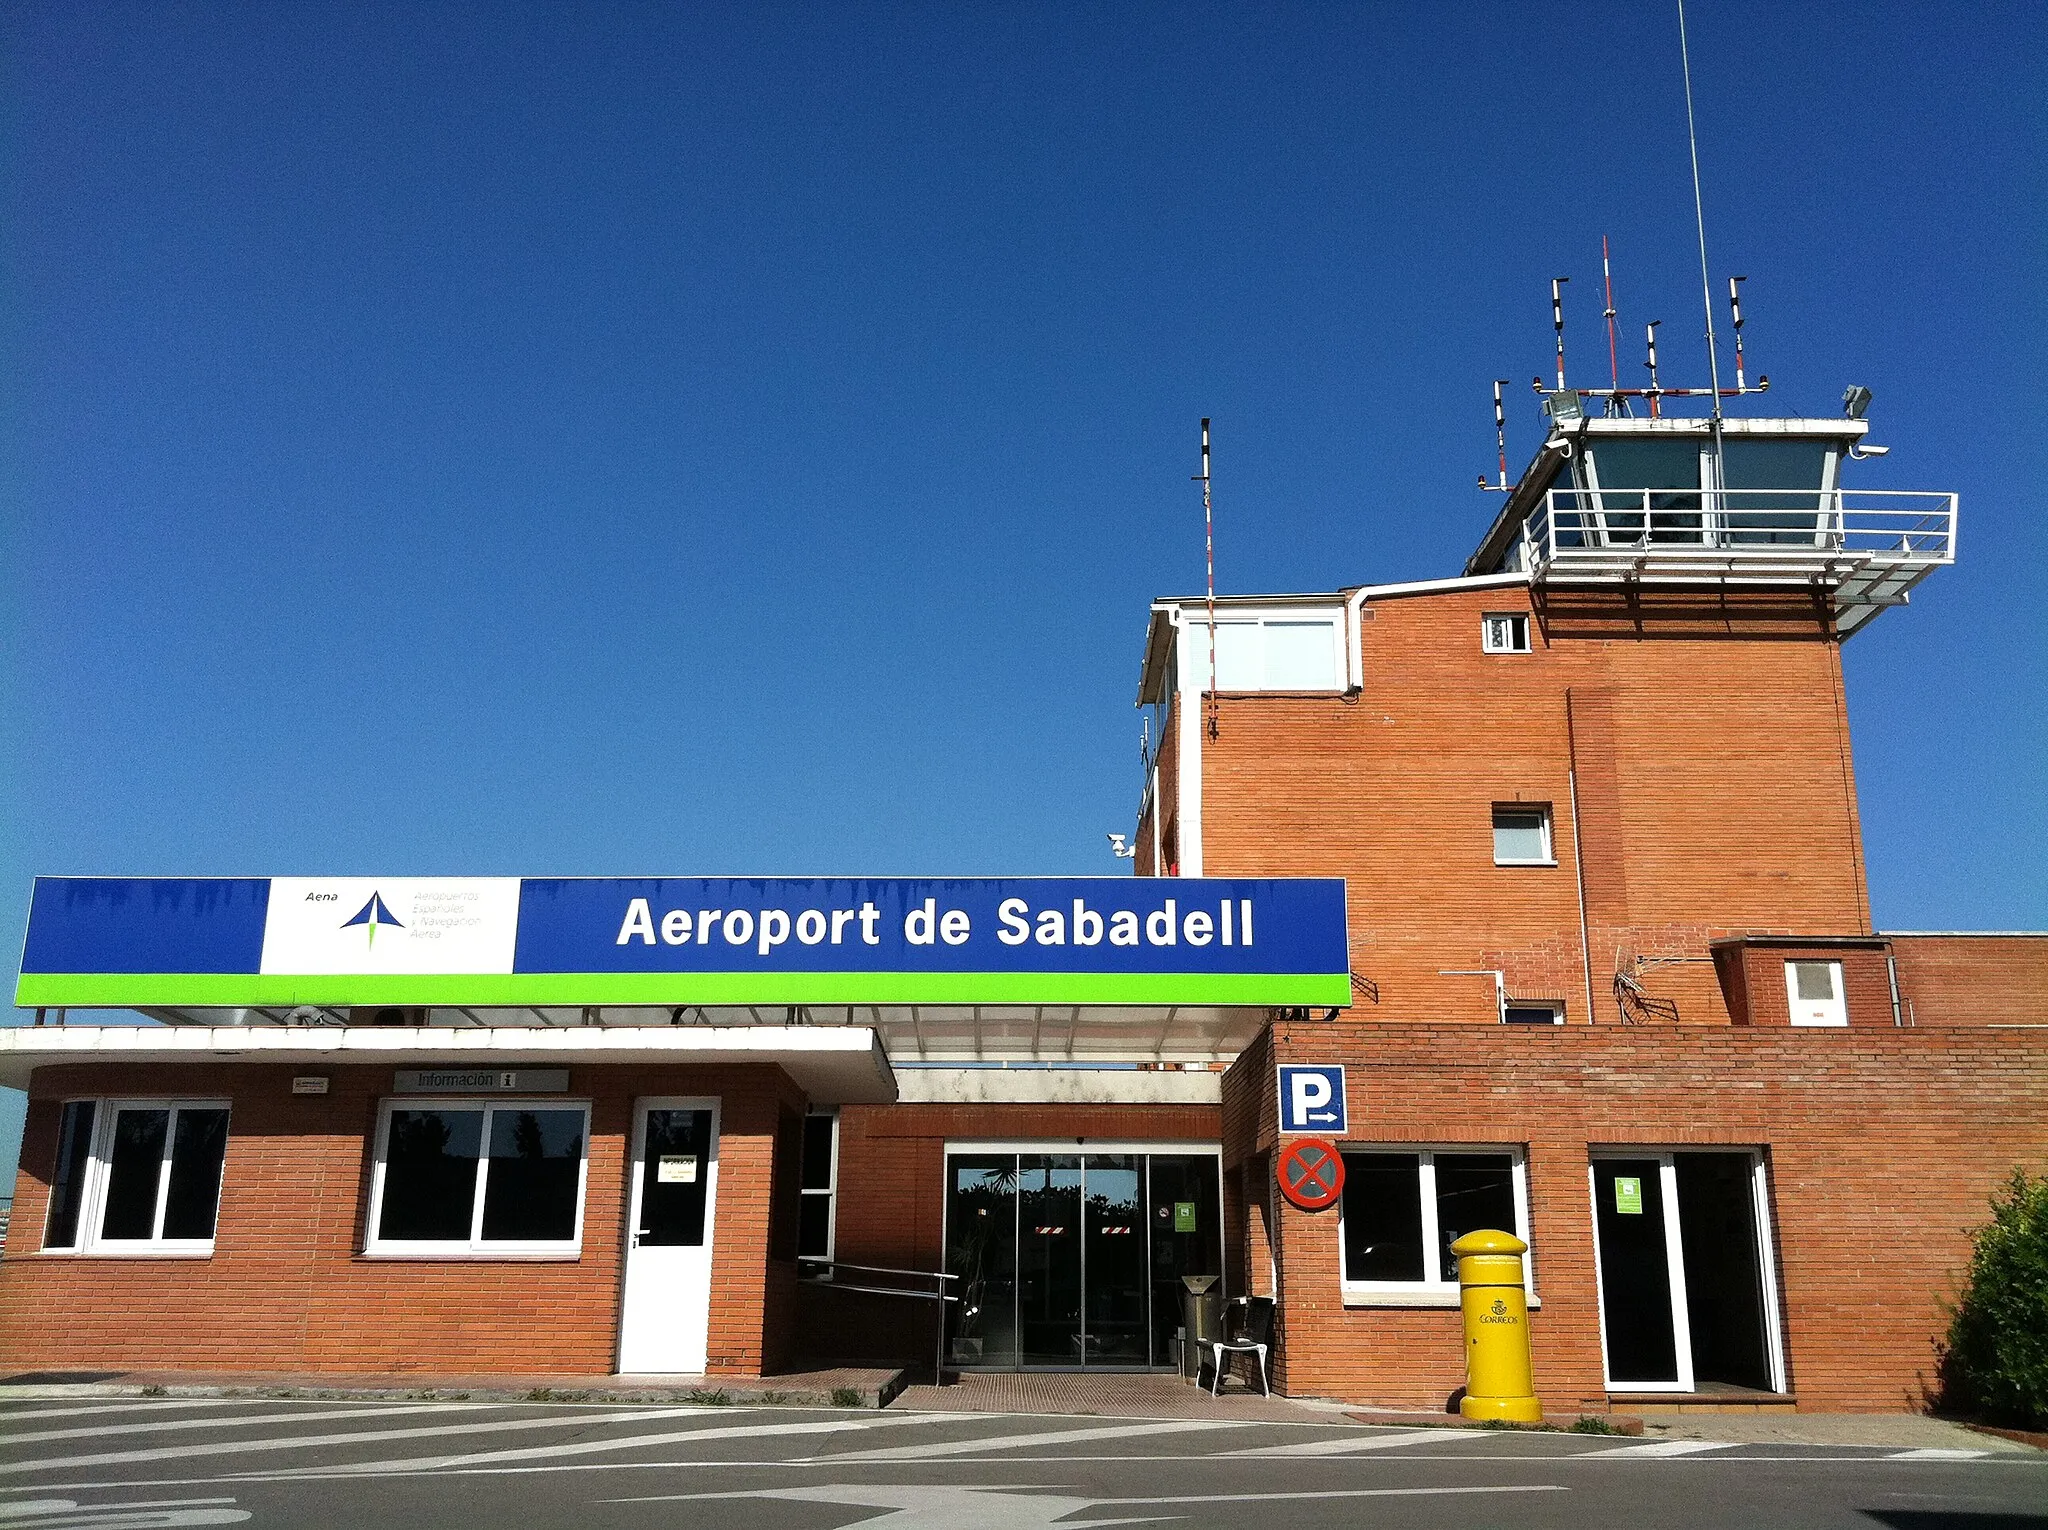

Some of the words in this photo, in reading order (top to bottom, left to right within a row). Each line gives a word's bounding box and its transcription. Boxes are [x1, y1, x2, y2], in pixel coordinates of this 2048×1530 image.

[305, 892, 338, 902] Aena
[413, 892, 479, 903] Aeropuertos
[616, 898, 881, 956] Aeroport
[904, 898, 971, 946] de
[997, 898, 1253, 947] Sabadell
[418, 1072, 493, 1087] Información
[1291, 1072, 1332, 1125] P
